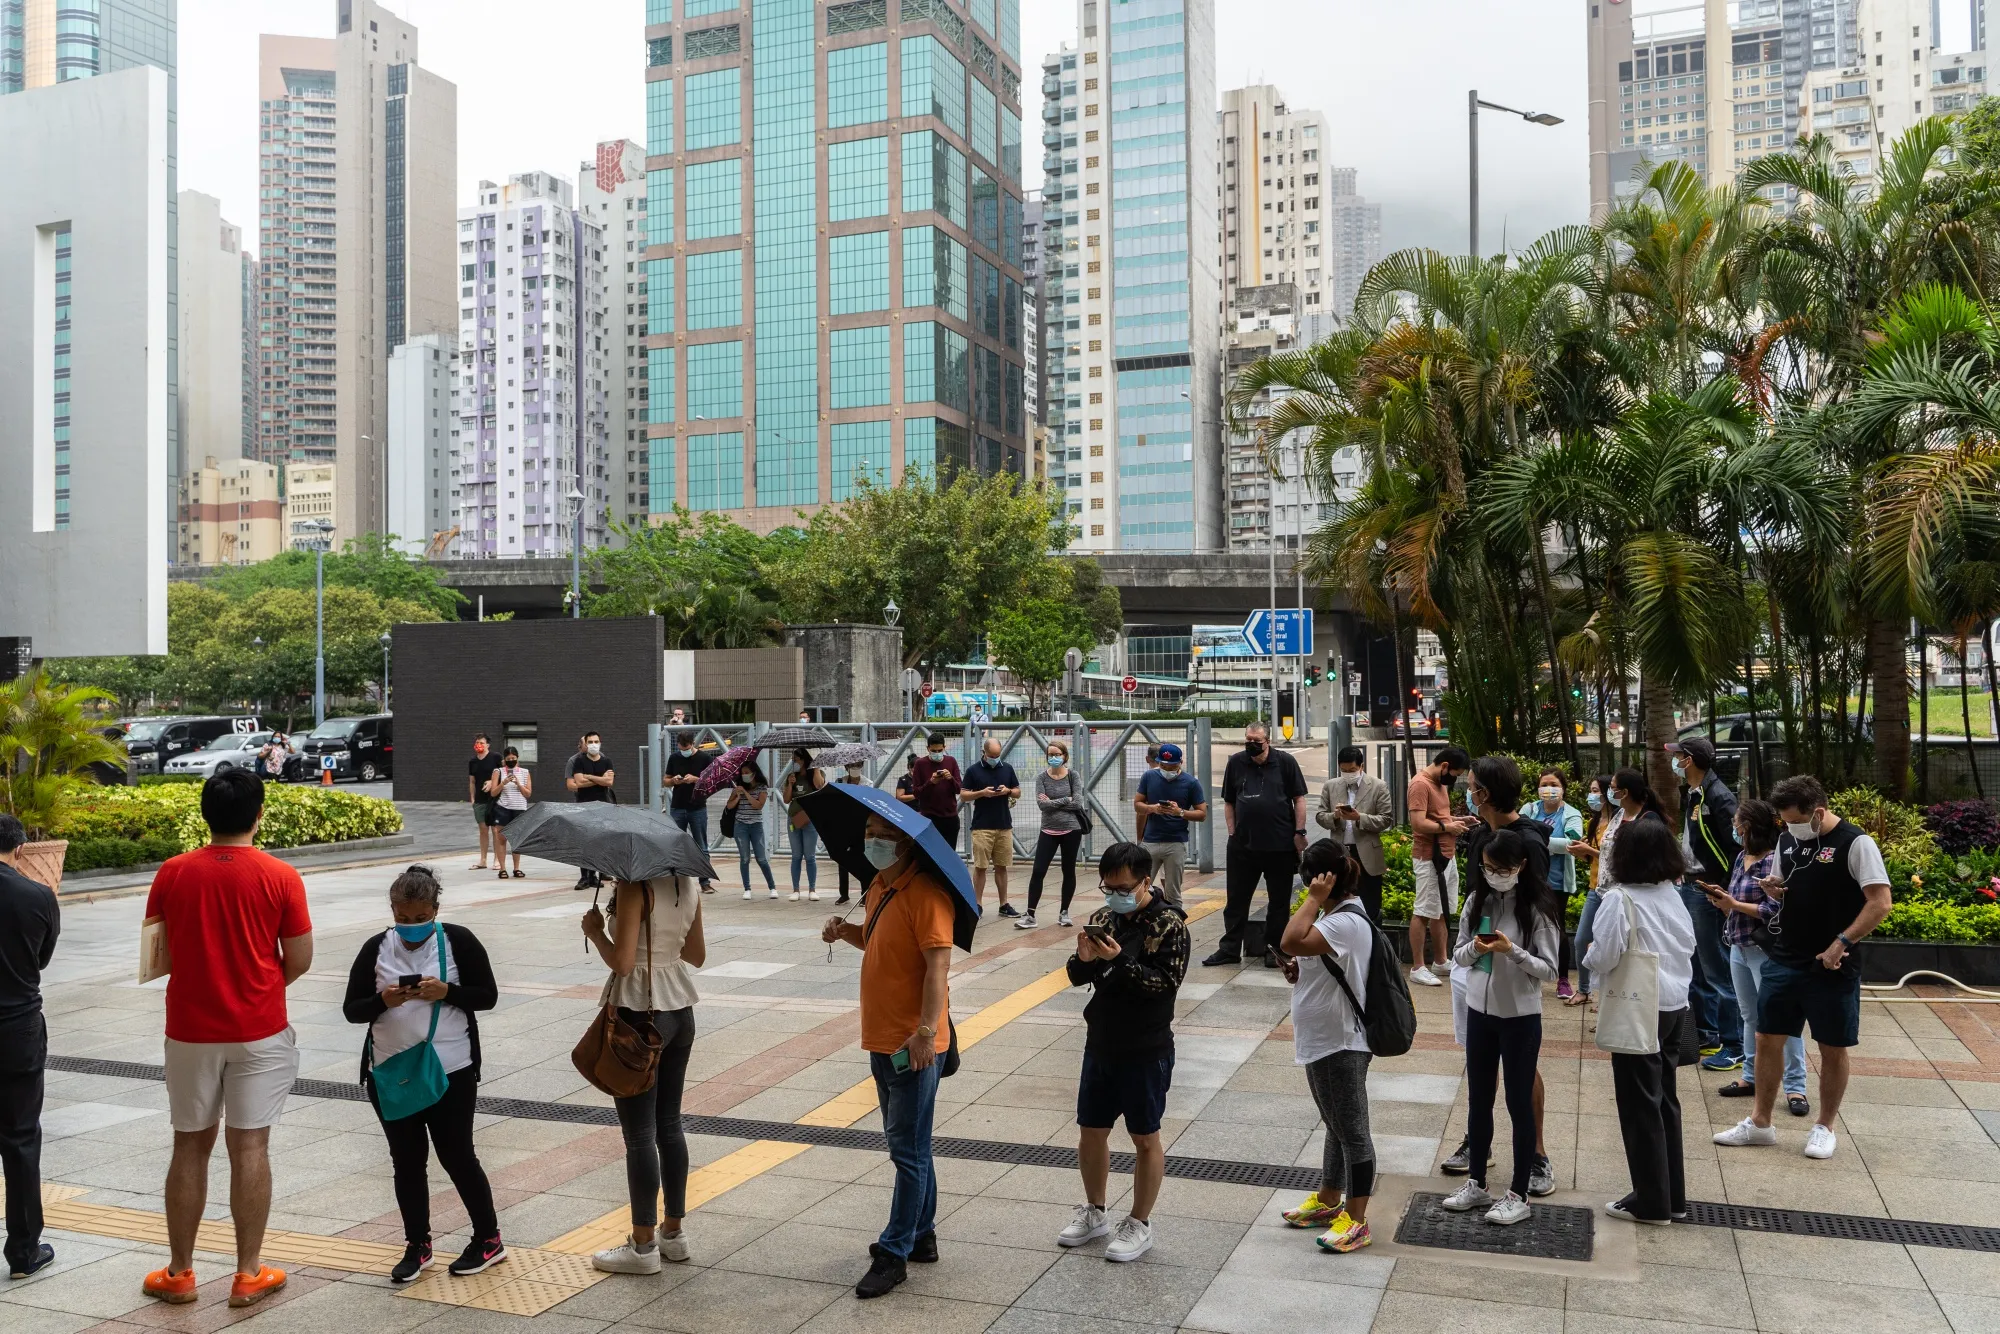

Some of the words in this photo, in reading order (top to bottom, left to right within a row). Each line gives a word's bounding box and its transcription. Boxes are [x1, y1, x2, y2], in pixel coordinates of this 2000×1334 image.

[1266, 613, 1289, 621] Seung
[1266, 632, 1288, 640] Cntral
[1801, 847, 1812, 856] RT
